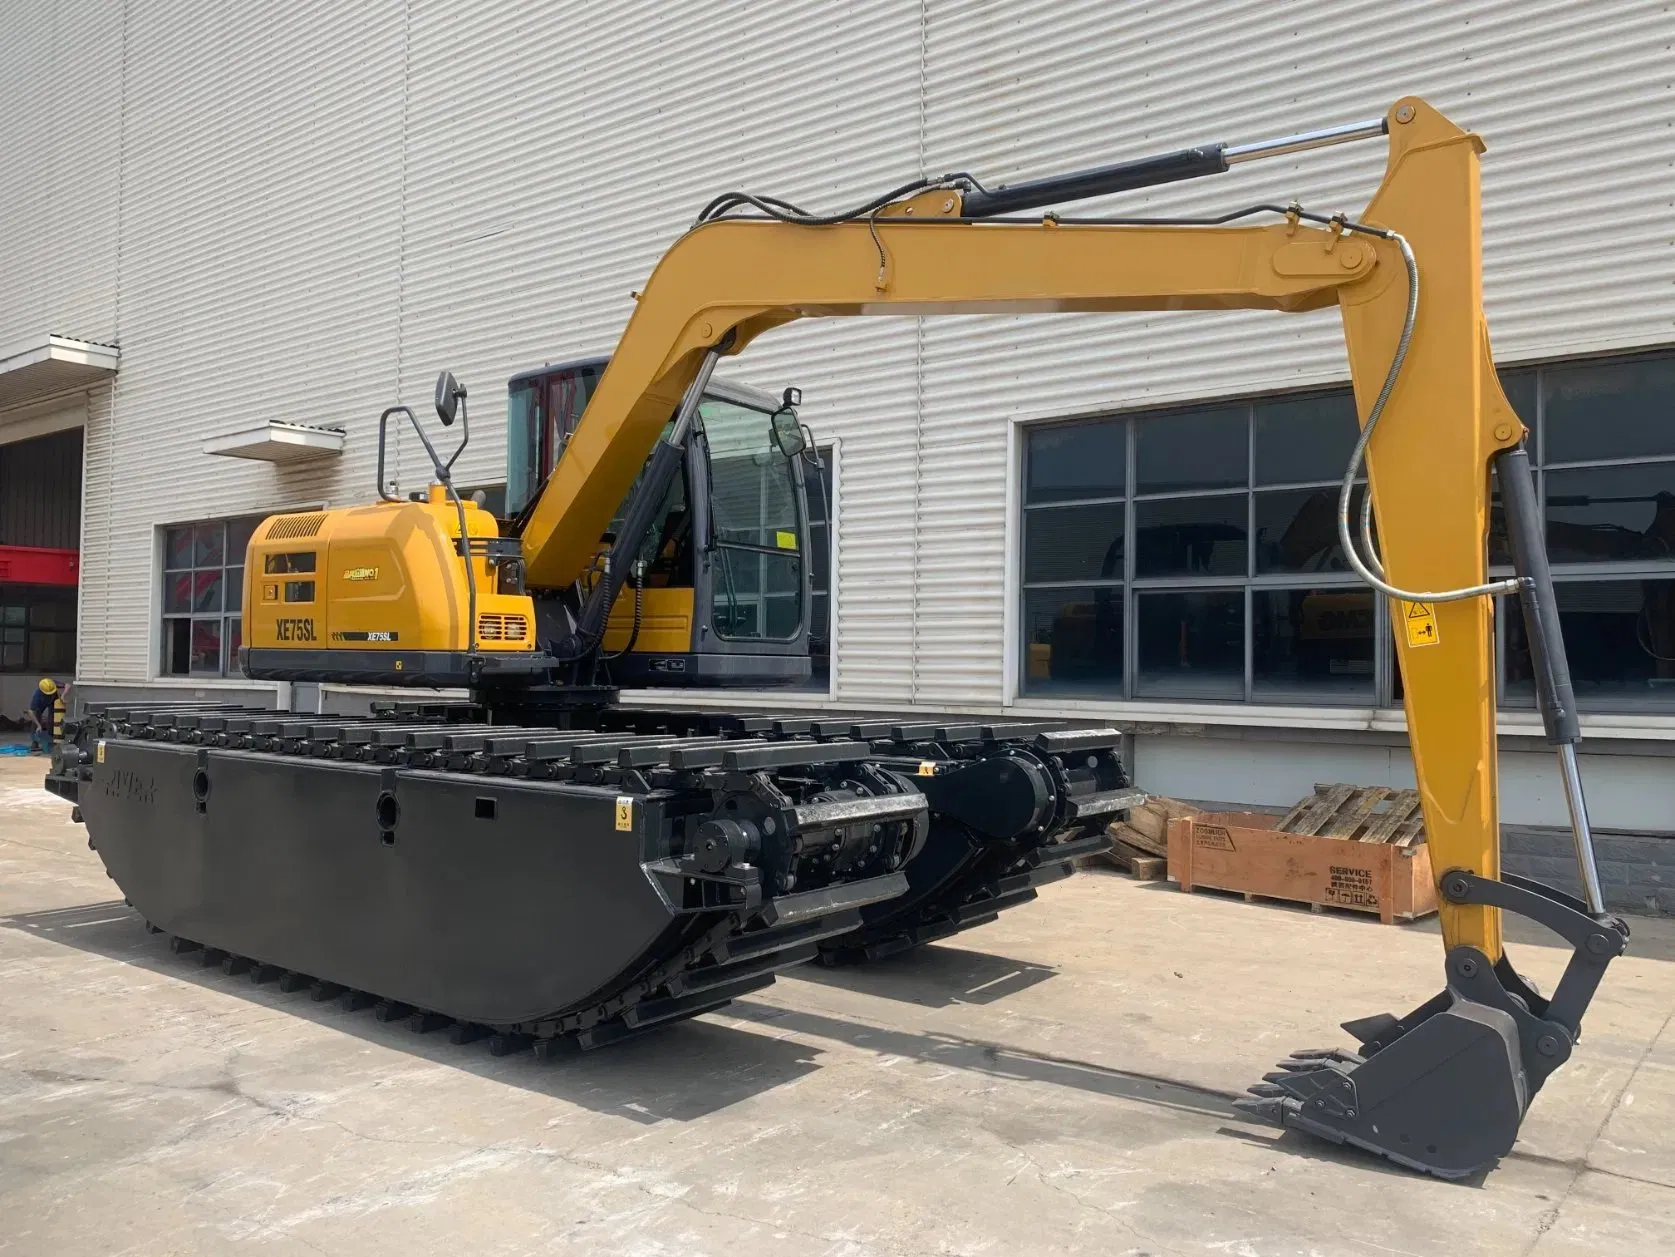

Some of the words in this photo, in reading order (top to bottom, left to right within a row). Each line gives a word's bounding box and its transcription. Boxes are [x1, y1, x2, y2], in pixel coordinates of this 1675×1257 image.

[276, 618, 317, 641] XE75SL
[367, 632, 391, 641] XE75SL
[1329, 865, 1373, 878] SERVICE
